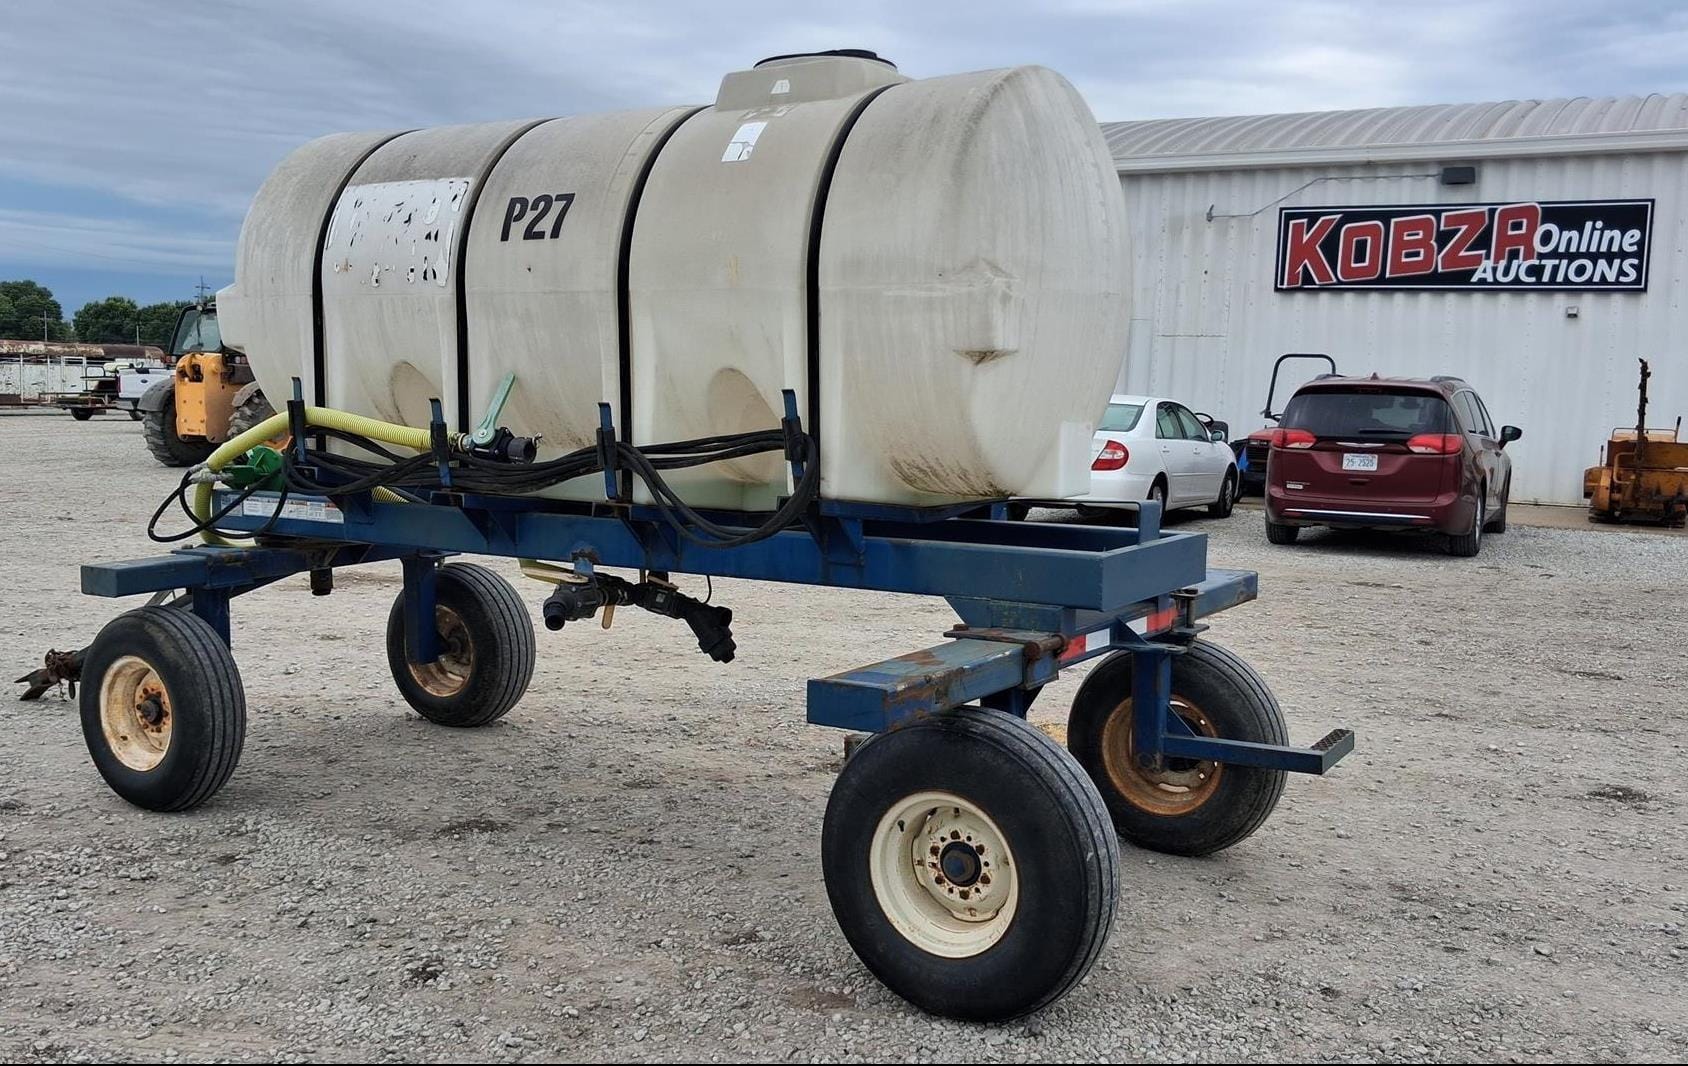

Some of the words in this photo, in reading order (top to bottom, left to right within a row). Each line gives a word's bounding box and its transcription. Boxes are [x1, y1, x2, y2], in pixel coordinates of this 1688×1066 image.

[501, 192, 576, 242] P27
[1284, 202, 1541, 288] KOBZA
[1533, 220, 1641, 254] Online
[1470, 258, 1639, 283] AUCTIONS
